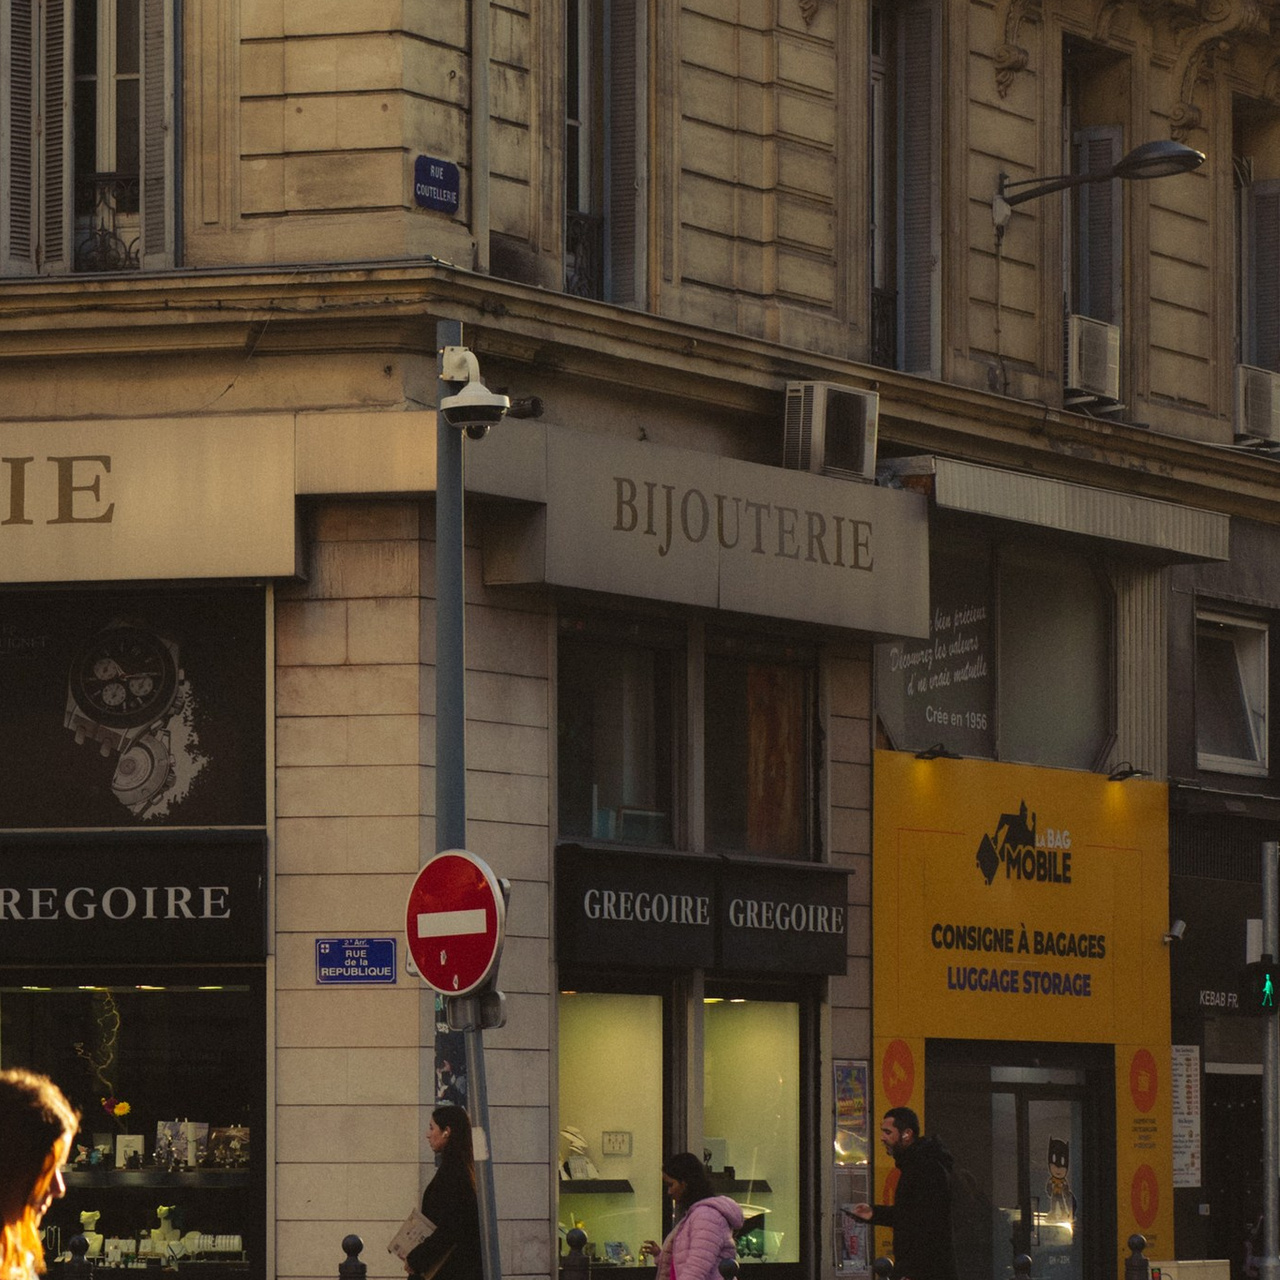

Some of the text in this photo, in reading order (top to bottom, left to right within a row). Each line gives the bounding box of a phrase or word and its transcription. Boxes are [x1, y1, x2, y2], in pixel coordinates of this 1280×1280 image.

[430, 164, 443, 179] RUE
[416, 183, 457, 203] COUTELLERIE
[613, 477, 875, 573] BIJOUTERIE
[935, 607, 952, 632] bien
[954, 604, 987, 633] précieux
[889, 633, 979, 672] Découvrez les valeurs
[929, 667, 952, 690] vraie
[953, 653, 988, 683] mutuelle
[925, 705, 988, 731] Crée en 1956
[1035, 828, 1072, 850] LA BAG
[1005, 843, 1072, 884] MOBILE
[584, 888, 710, 926] GREGOIRE
[729, 898, 845, 935] GREGOIRE
[931, 922, 1106, 959] CONSIGNE À BAGAGES
[321, 967, 391, 976] REPUBLIQUE
[947, 966, 1092, 997] LUGGAGE STORAGE
[1199, 990, 1226, 1007] KEBAB
